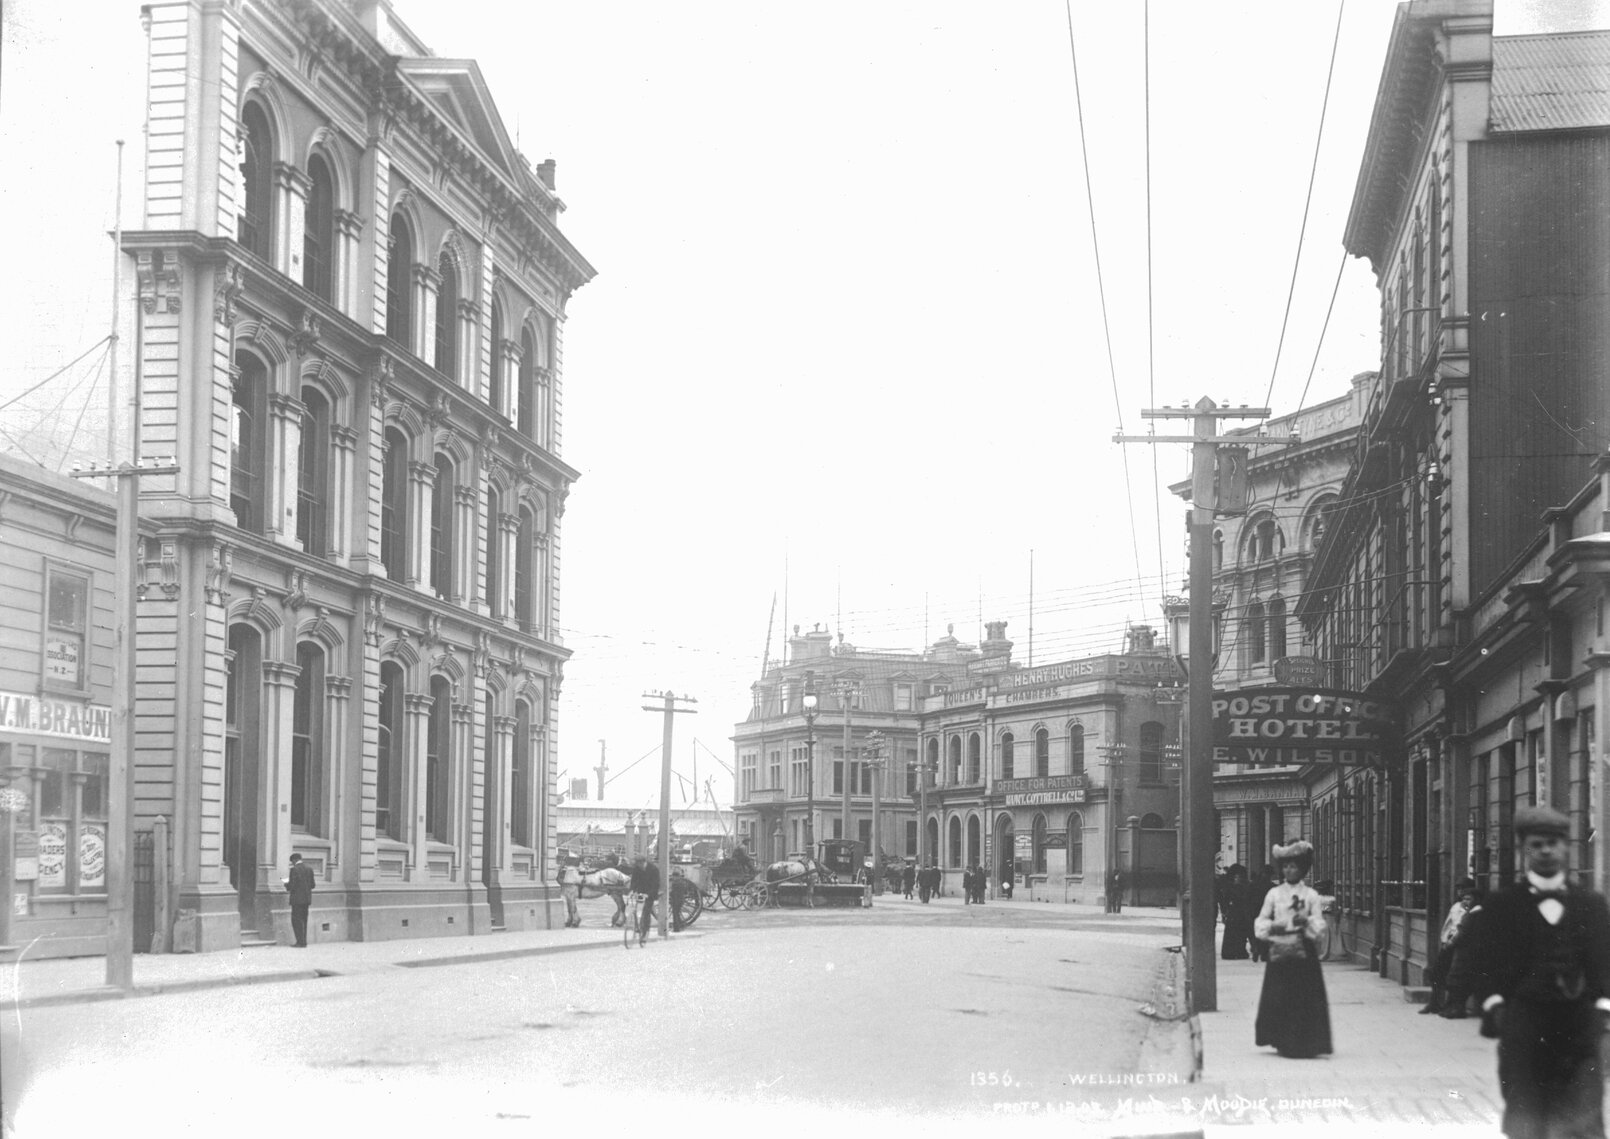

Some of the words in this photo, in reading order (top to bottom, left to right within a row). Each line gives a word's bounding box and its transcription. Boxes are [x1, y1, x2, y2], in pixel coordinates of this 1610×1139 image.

[1014, 670, 1050, 688] HENRY
[1051, 662, 1094, 683] HUGHES
[948, 687, 983, 707] QUEEN'S
[1211, 695, 1290, 719] POST
[997, 780, 1025, 792] OFFICE
[1028, 778, 1045, 790] FOR
[1048, 775, 1082, 788] PATENTS
